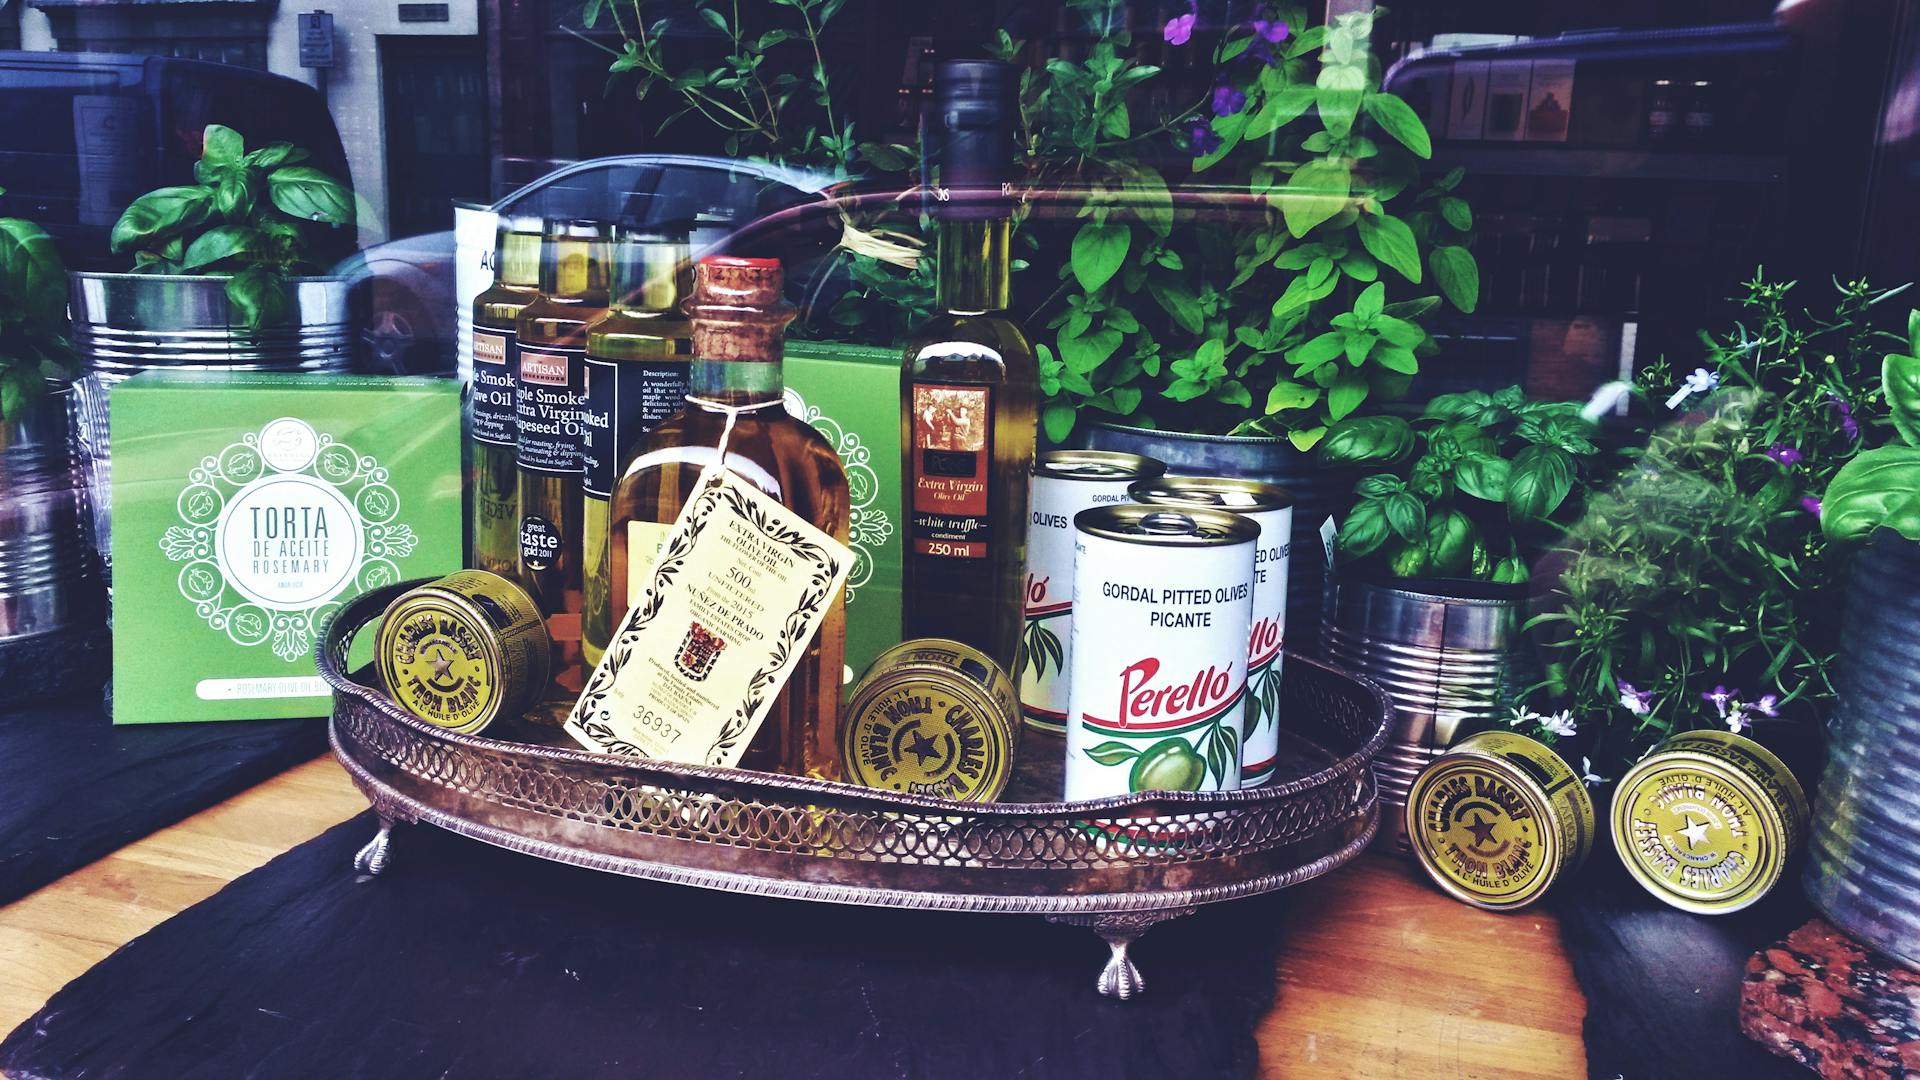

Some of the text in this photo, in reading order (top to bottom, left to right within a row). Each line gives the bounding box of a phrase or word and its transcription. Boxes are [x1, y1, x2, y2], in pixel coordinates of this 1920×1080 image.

[522, 362, 565, 377] ARTISAN
[490, 391, 512, 407] Oil
[642, 393, 661, 401] maple
[538, 404, 585, 425] Virgin
[918, 477, 984, 495] Extra Virgin
[933, 493, 966, 502] Olive Oil
[1092, 494, 1119, 503] GORDAL
[250, 506, 329, 539] TORTA
[527, 523, 546, 533] great
[1033, 511, 1068, 529] OLIVES
[253, 540, 329, 558] DE ACEITE
[520, 530, 558, 549] taste
[729, 520, 795, 568] EXTRA VIRGIN
[931, 532, 966, 540] condiment
[523, 546, 553, 558] gold 2011
[720, 535, 731, 545] THE
[730, 541, 757, 561] FLOWER
[756, 556, 765, 567] OF
[764, 561, 777, 574] THE
[736, 536, 779, 569] OLIVE OIL
[928, 542, 970, 557] 250 ml
[253, 559, 329, 574] ROSEMARY
[726, 566, 752, 589] 500
[708, 571, 765, 613] UNFILTERED
[1102, 581, 1249, 606] GORDAL PITTED OLIVES
[687, 583, 764, 641] NUÑEZ DE PRADO
[690, 599, 751, 642] FAMILY ESTATES CROP
[730, 600, 754, 620] 2015
[1150, 612, 1212, 628] PICANTE
[439, 615, 483, 662] BASSET
[690, 609, 742, 647] ORGANIC FARMING
[407, 675, 482, 713] THON BLANC
[1119, 657, 1233, 729] Perelló
[427, 710, 451, 722] HUILE
[462, 699, 481, 718] OLIVE
[867, 697, 893, 723] HUILE
[883, 696, 933, 726] THON
[633, 705, 682, 744] 36937
[860, 735, 872, 766] OLIVE
[870, 723, 898, 783] BLANC
[945, 704, 985, 780] CHARLES
[1659, 774, 1690, 788] OLIVE
[1704, 779, 1737, 800] HUILE
[1428, 776, 1473, 833] CHARLES
[1474, 776, 1531, 822] BASSET
[1650, 783, 1706, 810] BLANC
[1709, 793, 1748, 838] THON
[1444, 838, 1532, 880] THON BLANC
[1633, 818, 1680, 878] BASSET
[1472, 877, 1501, 888] HUILE
[1513, 861, 1535, 883] OLIVE
[1680, 851, 1750, 890] CHARLES
